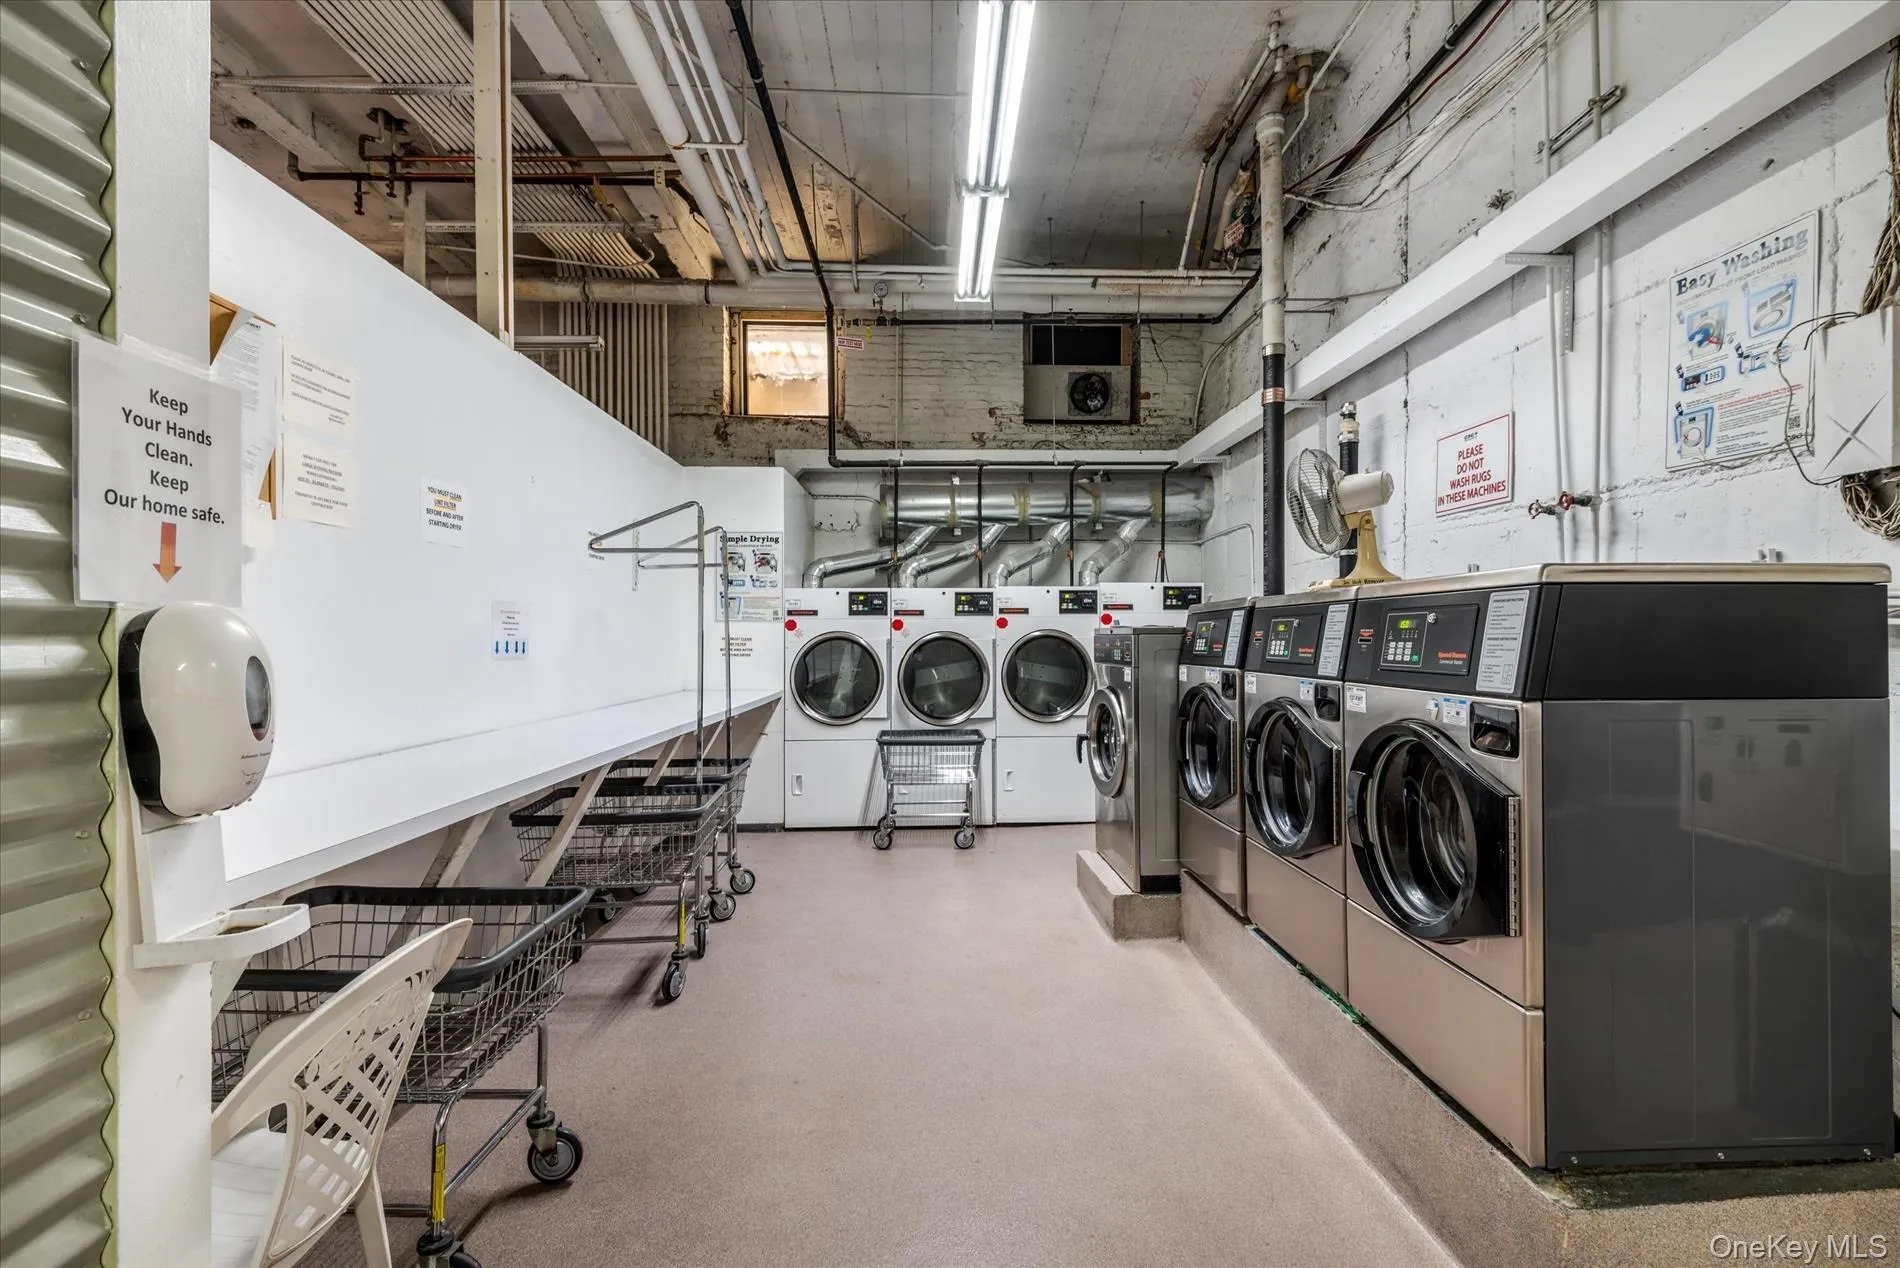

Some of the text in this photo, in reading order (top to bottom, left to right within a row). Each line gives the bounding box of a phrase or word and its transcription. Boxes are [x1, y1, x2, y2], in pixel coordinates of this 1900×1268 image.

[1676, 267, 1718, 297] Easy
[1721, 228, 1809, 276] Washing
[150, 388, 189, 416] Keep
[121, 406, 212, 446] Your Hands
[145, 442, 193, 467] Clean.
[1458, 443, 1484, 461] PLEASE
[1456, 457, 1485, 475] DO NOT
[150, 469, 189, 494] Keep
[1450, 469, 1492, 490] WASH RUGS
[1437, 480, 1506, 507] IN THESE MACHINES
[104, 488, 225, 525] Our home safe.
[720, 535, 780, 544] Smple Drying
